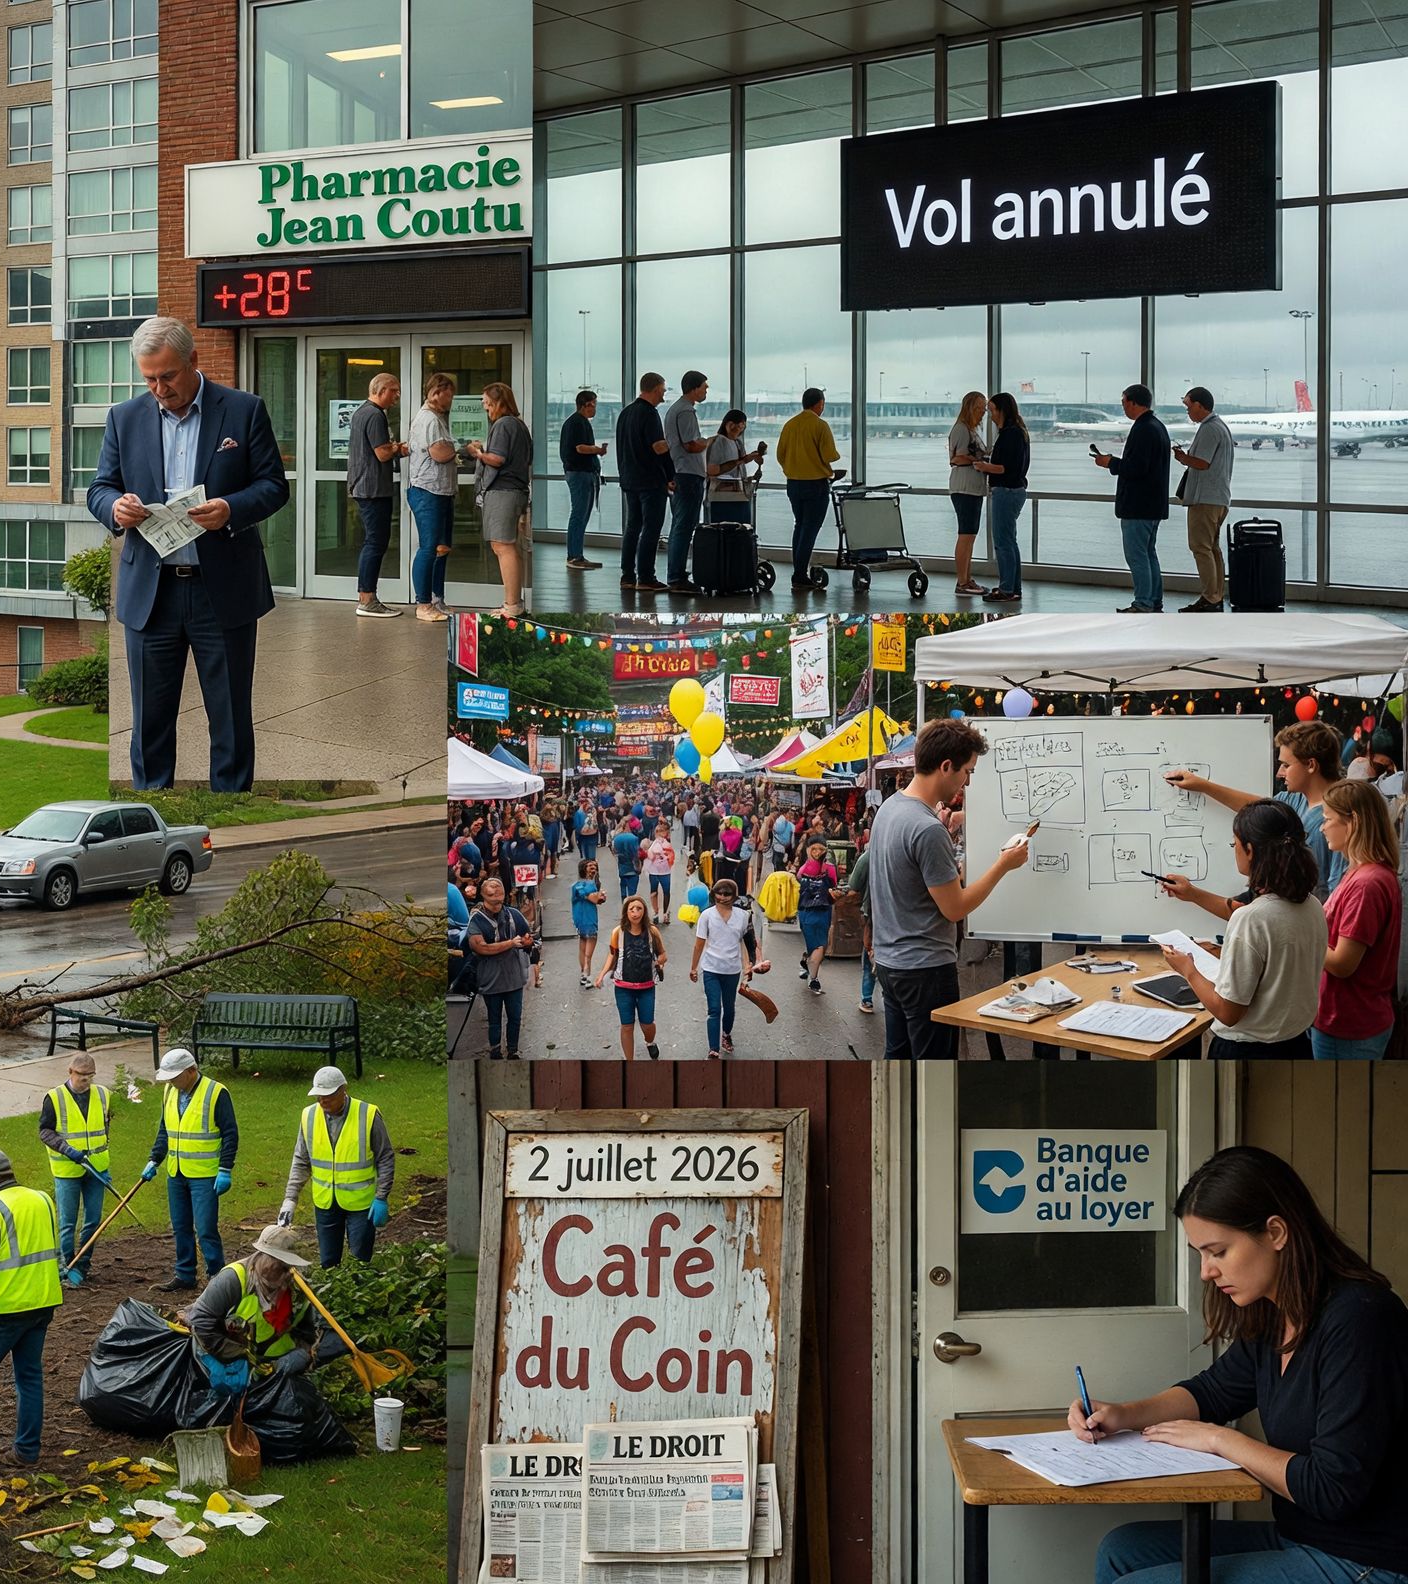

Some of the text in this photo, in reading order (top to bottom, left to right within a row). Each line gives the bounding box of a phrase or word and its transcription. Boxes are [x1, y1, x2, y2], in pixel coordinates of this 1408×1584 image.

[258, 145, 521, 205] Pharmacie
[256, 196, 524, 247] Jean Coutu
[885, 151, 1211, 249] Vol annulé
[528, 1143, 760, 1192] 2 juillet 2026
[1037, 1137, 1150, 1171] Banque
[1036, 1166, 1128, 1193] d'aide
[1036, 1194, 1155, 1228] au loyer
[542, 1212, 717, 1299] Café
[515, 1315, 753, 1396] du Coin
[509, 1455, 583, 1478] LE DR
[612, 1434, 725, 1459] LE DROIT
